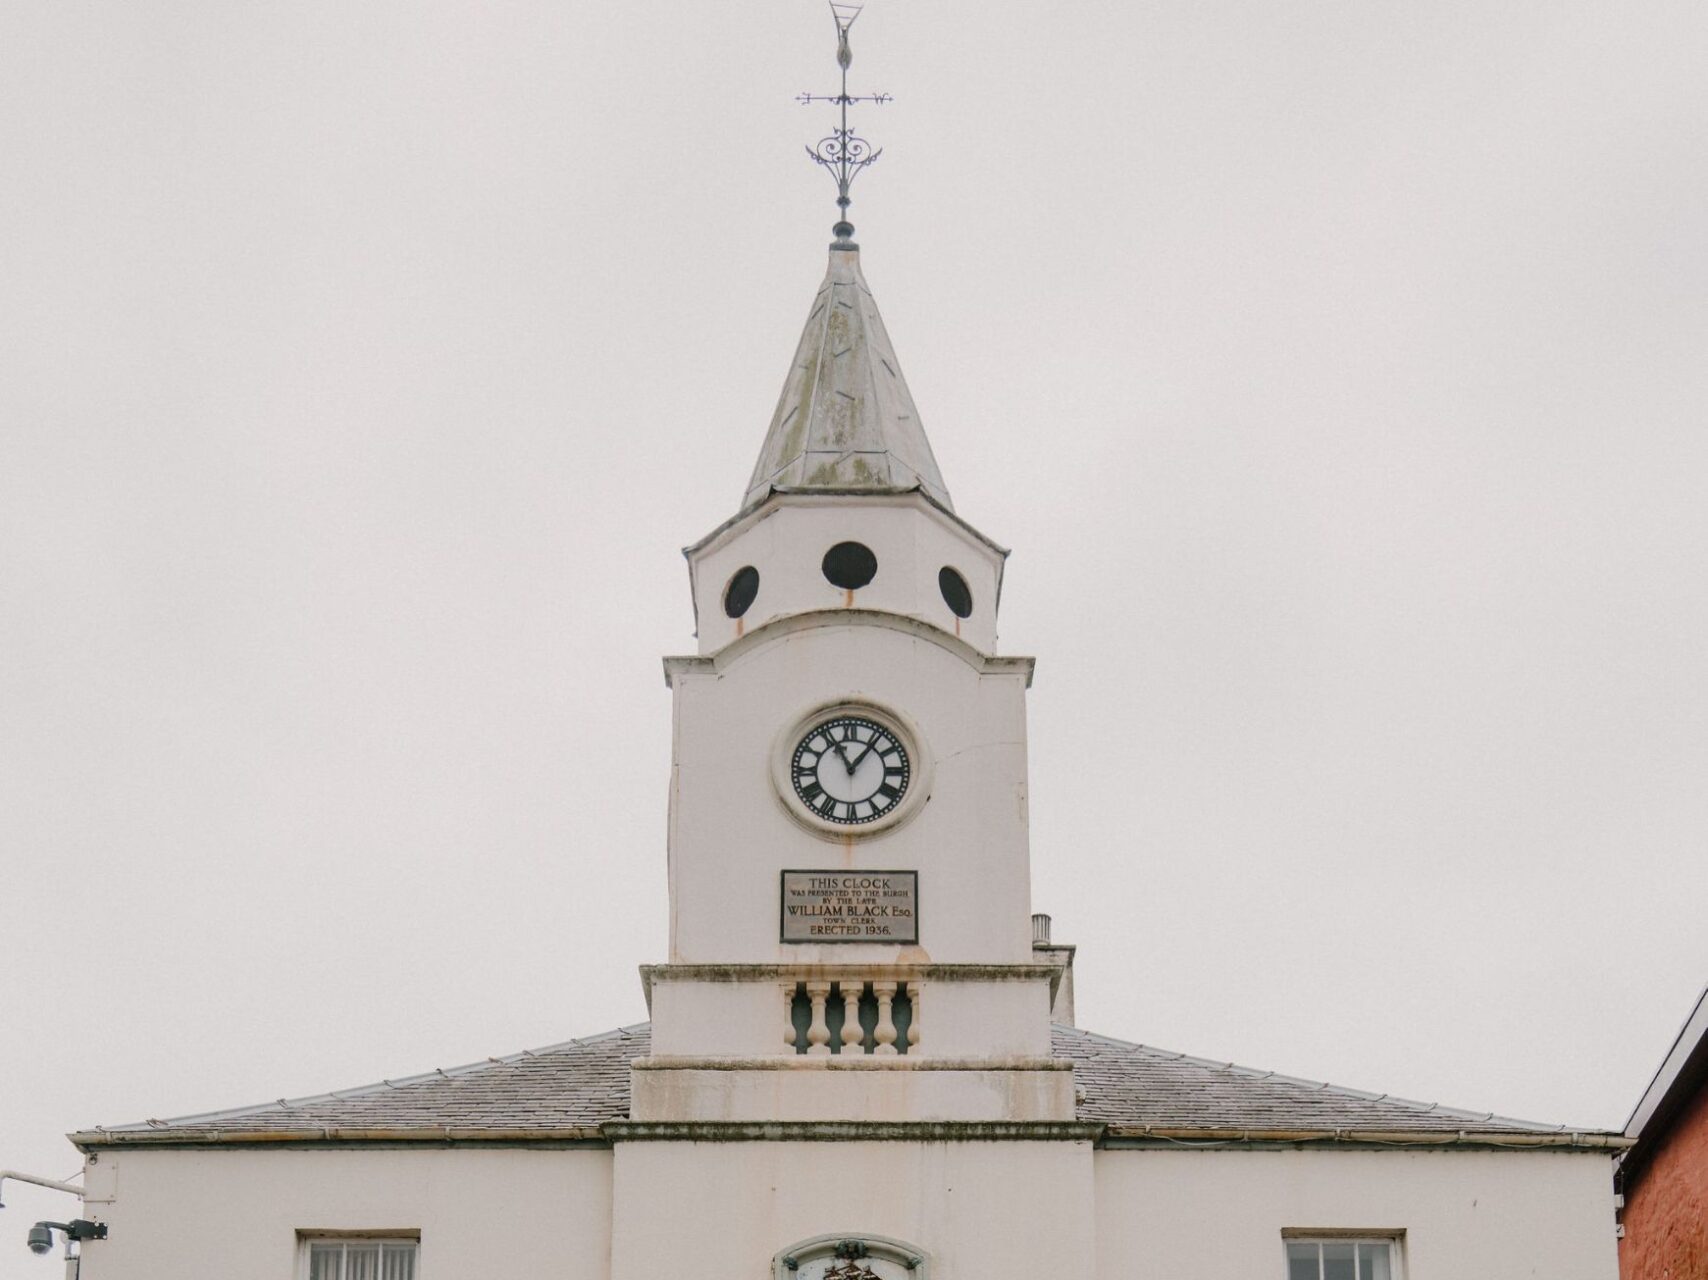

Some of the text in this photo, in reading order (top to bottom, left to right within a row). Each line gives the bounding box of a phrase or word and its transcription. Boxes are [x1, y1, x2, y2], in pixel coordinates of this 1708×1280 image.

[809, 878, 891, 889] THIS CLOCK
[788, 906, 842, 916] WILLIAM
[847, 906, 889, 916] BLACK
[810, 926, 861, 935] ERECTED
